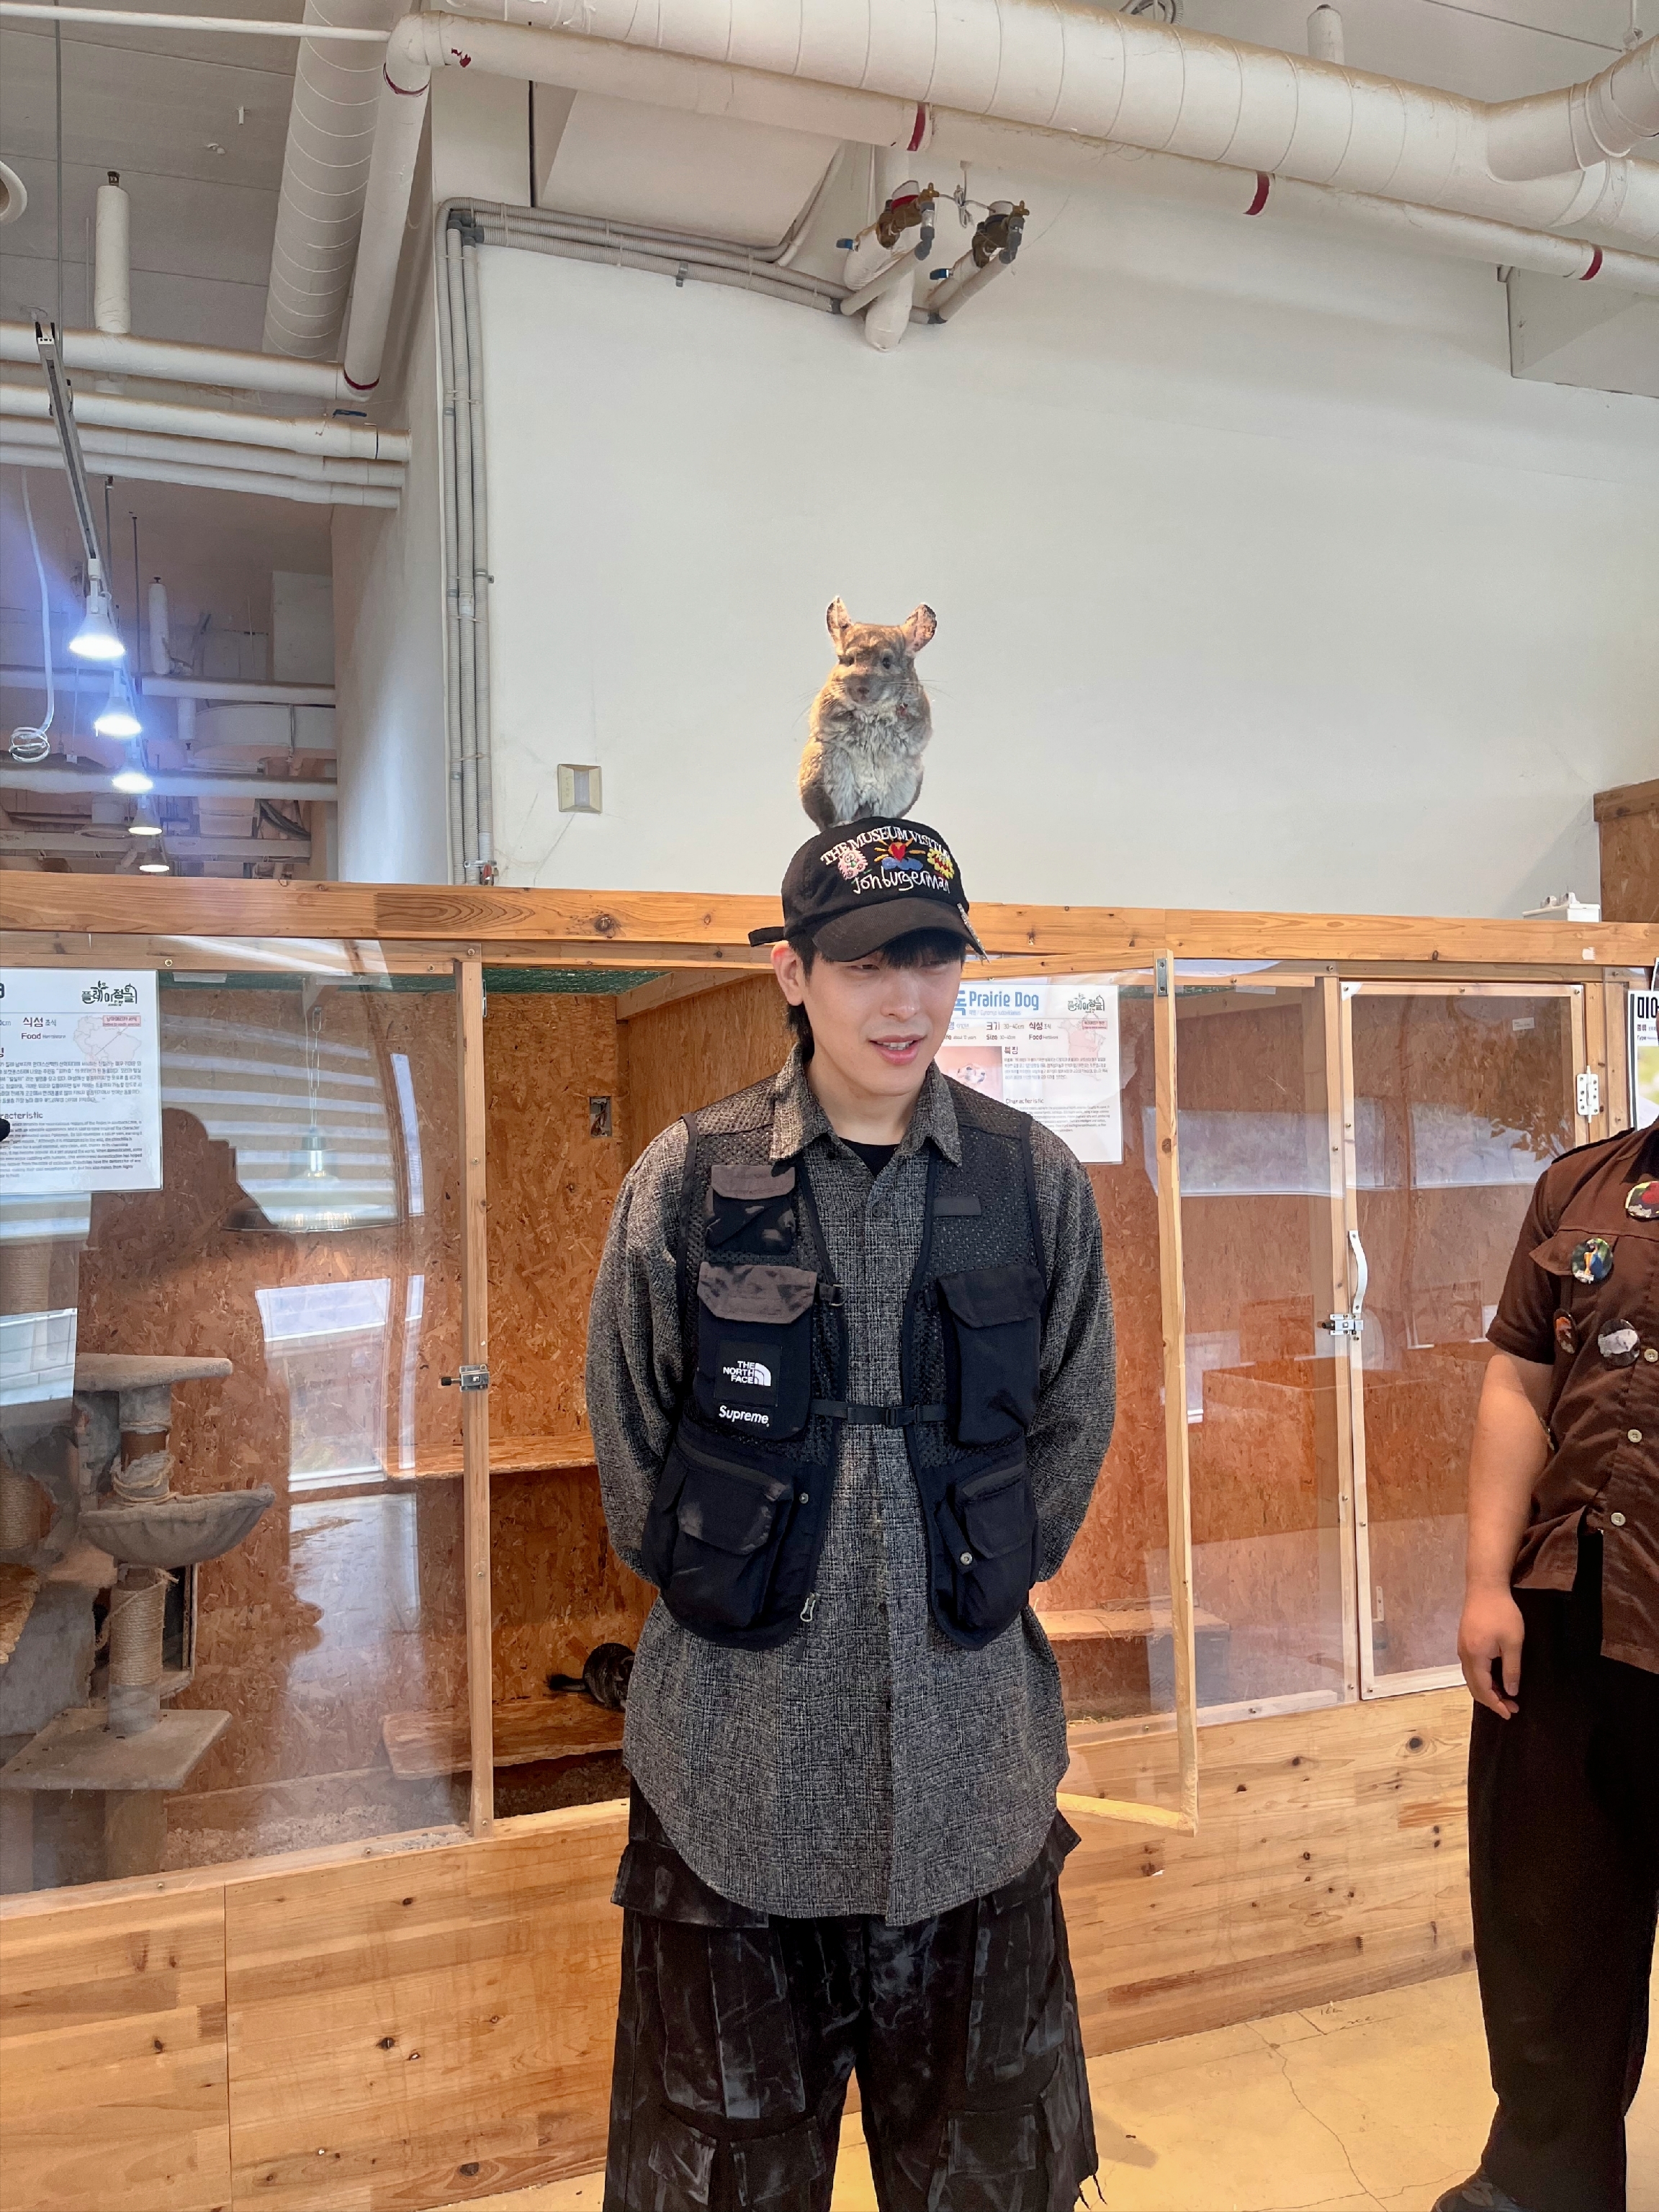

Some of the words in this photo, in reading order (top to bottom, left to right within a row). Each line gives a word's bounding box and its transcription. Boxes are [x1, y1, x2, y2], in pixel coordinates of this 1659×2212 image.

[820, 842, 851, 866] THE
[847, 826, 909, 850] MUSEUM
[969, 991, 1010, 1007] Prairie
[1015, 992, 1039, 1011] Dog
[986, 1022, 1000, 1030] 크기
[1029, 1022, 1043, 1030] 식성
[737, 1360, 755, 1369] THE
[723, 1367, 755, 1376] NORTH
[731, 1375, 755, 1384] FACE
[719, 1405, 769, 1424] Supreme
